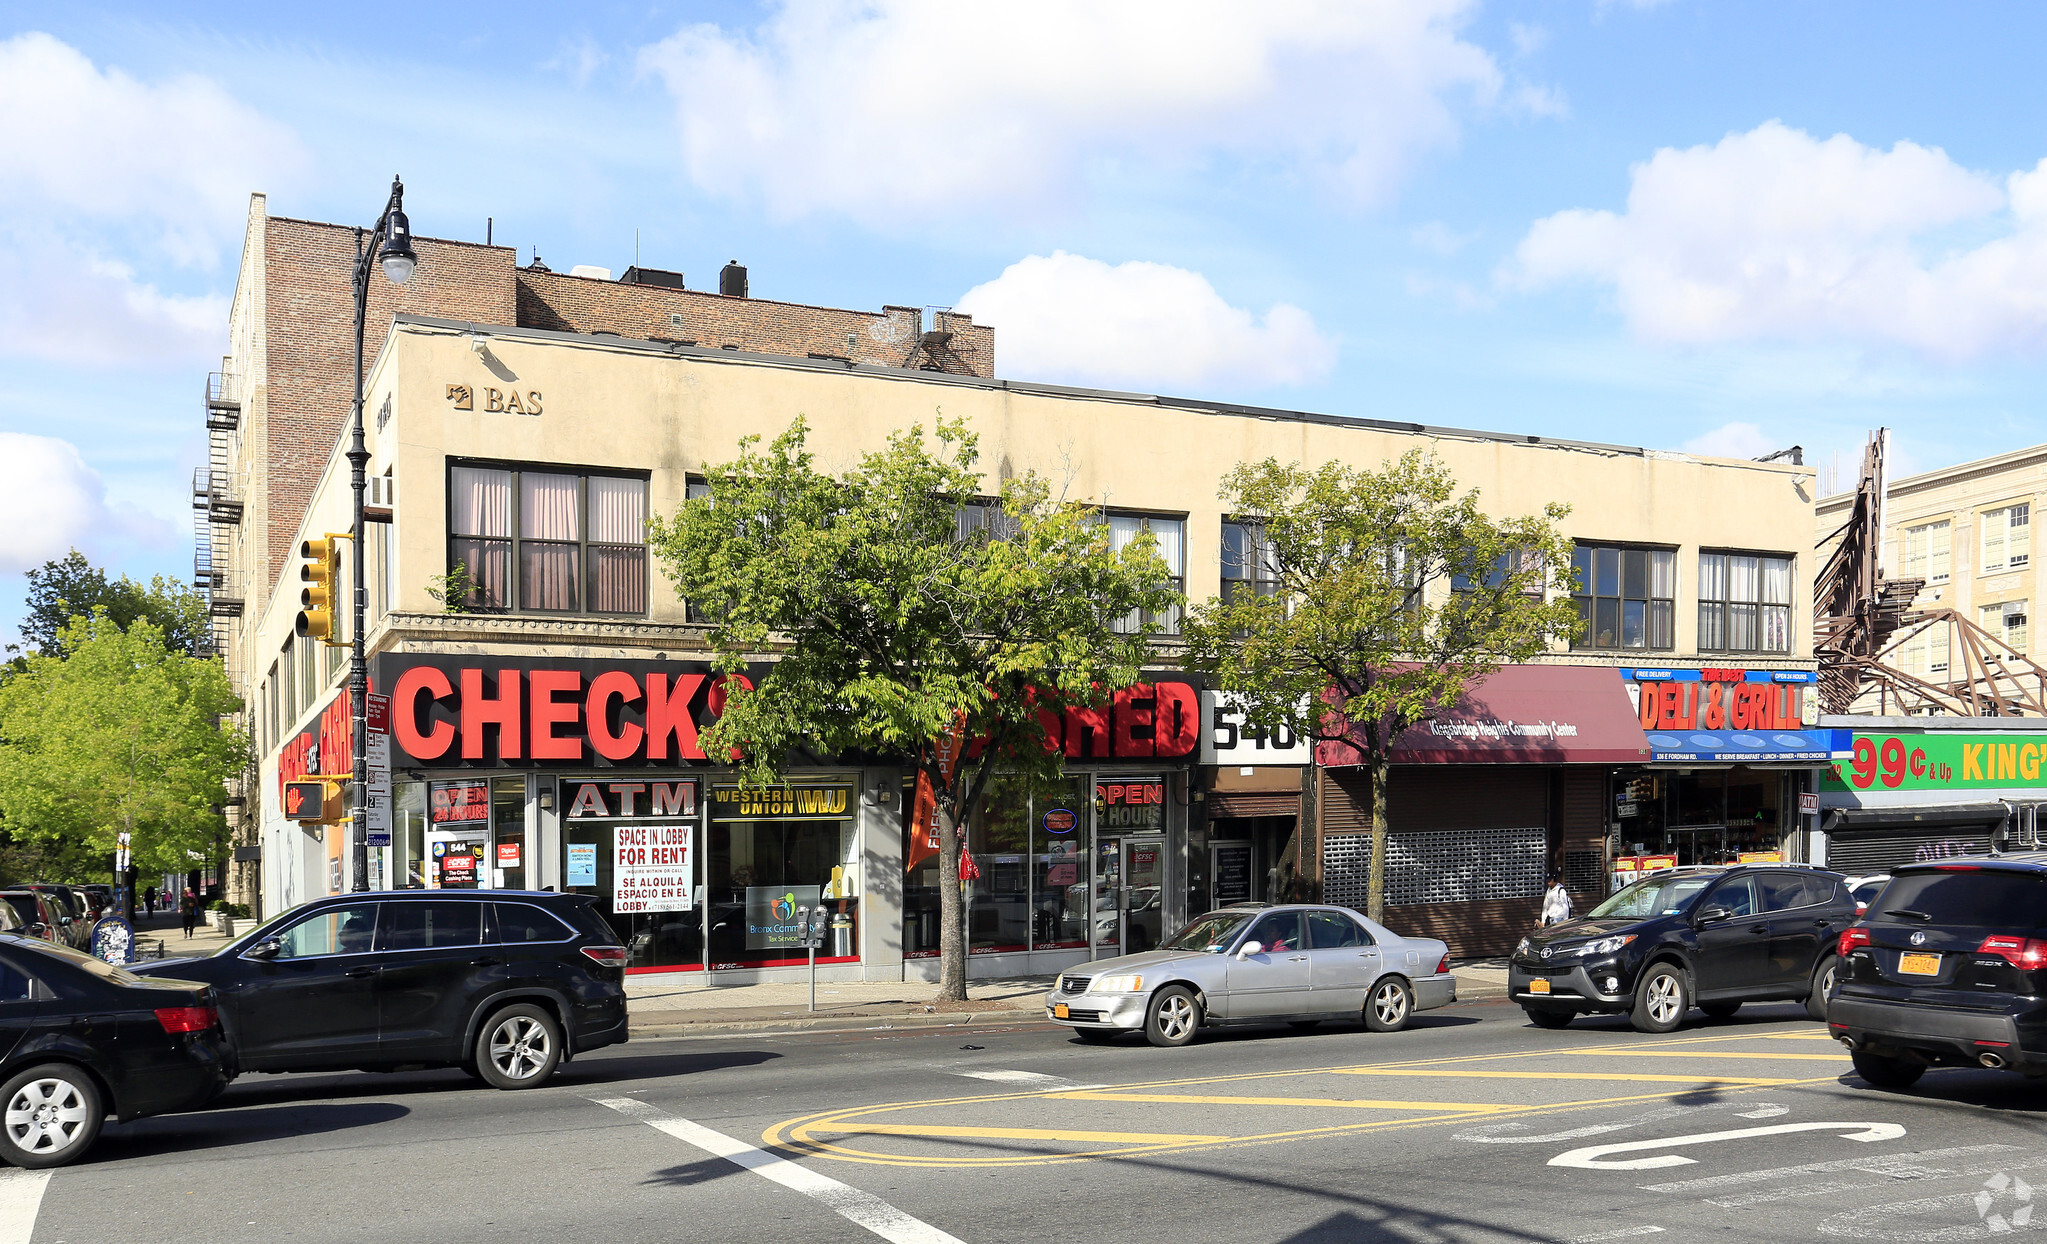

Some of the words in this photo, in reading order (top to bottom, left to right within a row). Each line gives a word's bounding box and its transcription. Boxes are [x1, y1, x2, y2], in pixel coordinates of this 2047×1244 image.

[484, 387, 543, 416] BAS
[1636, 670, 1649, 678] FREE
[1700, 668, 1722, 681] THE
[1722, 669, 1746, 682] BEST
[1641, 682, 1698, 730] DELI
[1705, 682, 1725, 730] &
[1731, 683, 1801, 730] GRILL
[1428, 720, 1480, 740] Kingsbridge
[1476, 720, 1509, 740] Heights
[1508, 720, 1552, 740] Community
[1551, 720, 1578, 738] Center
[1826, 764, 1841, 782] 532
[1930, 765, 1936, 780] &
[1940, 762, 1952, 783] Up
[369, 797, 374, 808] 2
[433, 787, 488, 805] OPEN
[568, 783, 694, 817] ATM
[715, 790, 794, 802] WESTERN
[1802, 796, 1816, 808] ATM
[433, 806, 448, 822] 24
[450, 804, 488, 820] HOURS
[740, 803, 794, 814] UNION
[1109, 806, 1161, 826] HOURS
[619, 828, 646, 846] SPACE
[650, 829, 658, 845] IN
[661, 828, 688, 845] LOBBY
[450, 843, 466, 852] 544
[452, 858, 472, 866] CFSC
[619, 848, 646, 865] FOR
[652, 847, 687, 864] RENT
[623, 878, 635, 888] SE
[640, 877, 683, 887] ALQUILA
[618, 889, 658, 899] ESPACIO
[662, 889, 673, 898] EN
[677, 888, 687, 897] EL
[750, 924, 772, 934] Bronx
[774, 924, 815, 935] Commty
[1974, 960, 2003, 968] MDX
